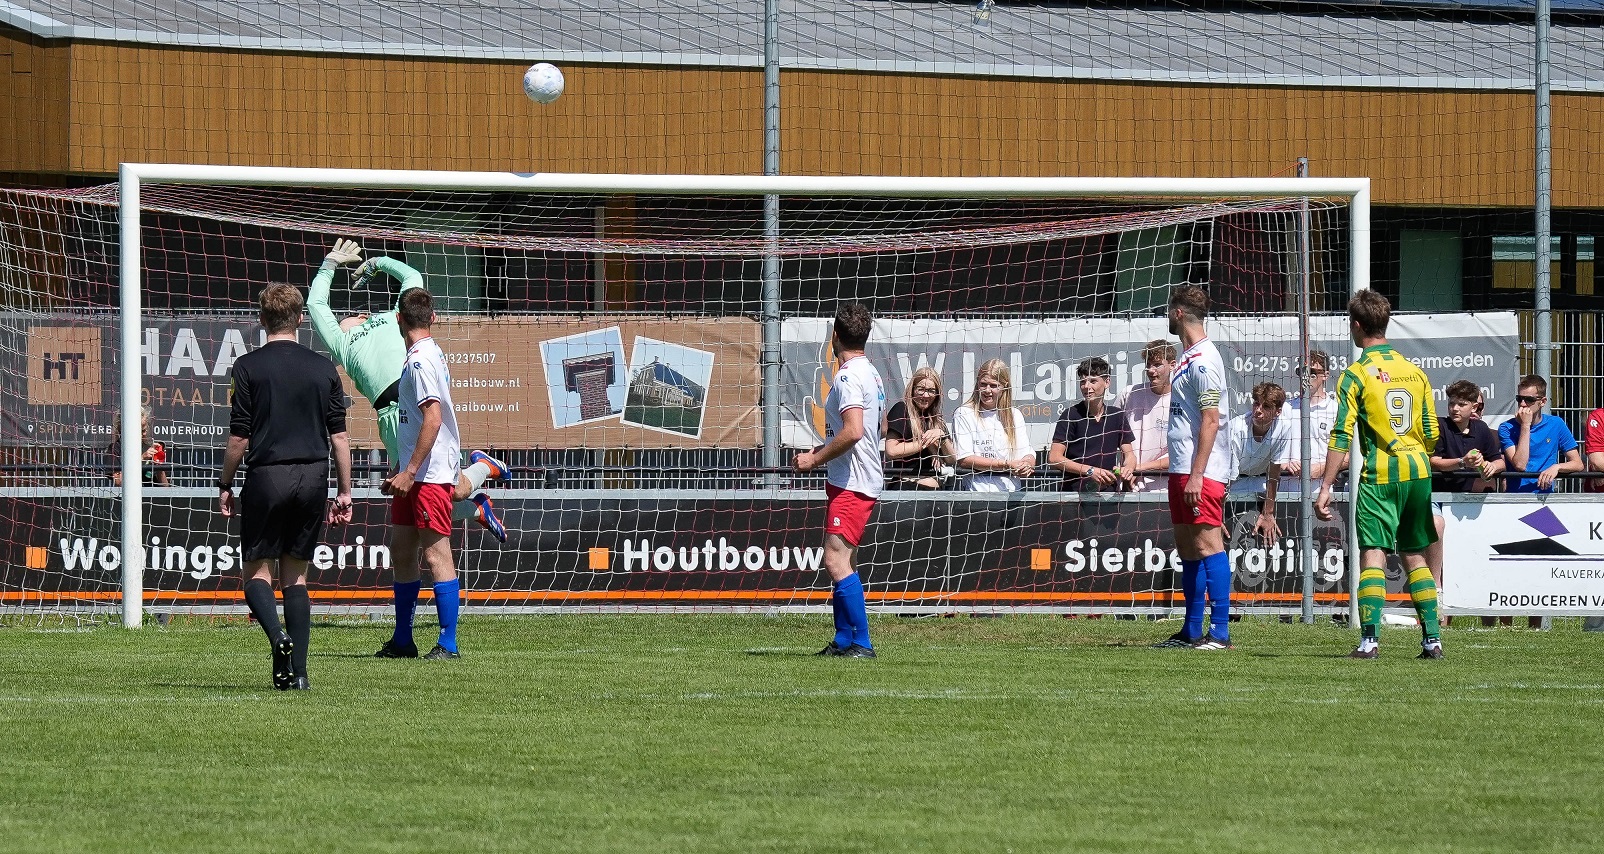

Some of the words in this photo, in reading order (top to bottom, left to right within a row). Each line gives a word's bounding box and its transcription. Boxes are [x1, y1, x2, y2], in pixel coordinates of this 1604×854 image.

[43, 352, 86, 380] HT
[445, 353, 496, 364] 13237507
[1233, 356, 1290, 372] 06-275
[451, 377, 521, 388] taalbouw.nl
[454, 401, 520, 412] aalbouw.nl
[1385, 387, 1414, 436] 9
[84, 425, 113, 435] VERB
[153, 425, 224, 435] ONDERHOUD
[623, 537, 824, 571] Houtbouw
[1064, 538, 1345, 582] Sierberating
[1489, 592, 1588, 607] PRODUCEREN
